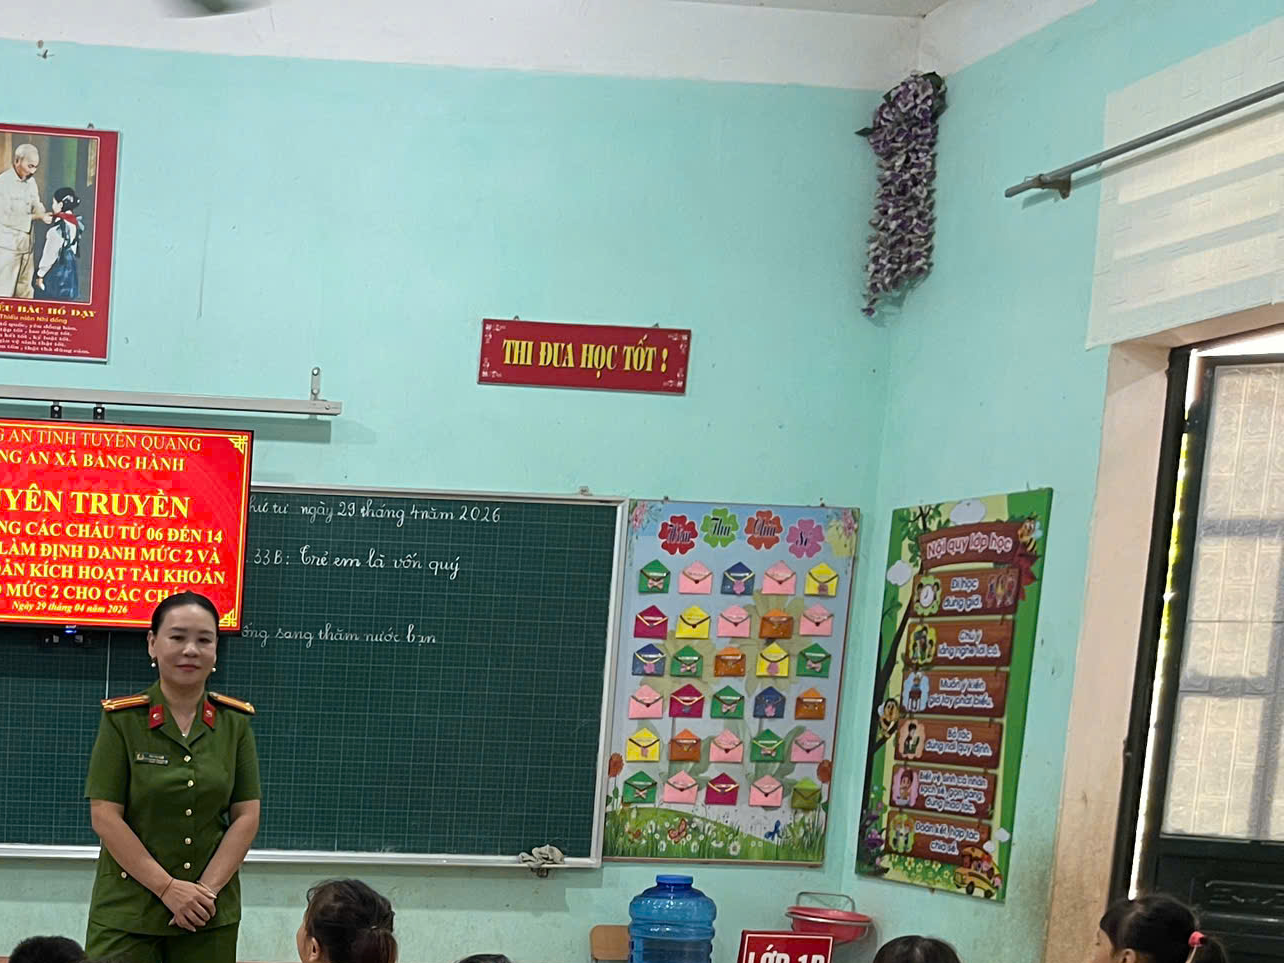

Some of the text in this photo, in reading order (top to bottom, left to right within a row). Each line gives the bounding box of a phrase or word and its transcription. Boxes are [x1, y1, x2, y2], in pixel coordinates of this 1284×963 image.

[503, 339, 534, 366] THI
[538, 341, 575, 368] ĐUA
[580, 343, 618, 378] HỌC
[622, 334, 657, 372] TỐT
[8, 429, 32, 444] AN
[141, 435, 202, 452] QUANG
[26, 451, 51, 465] AN
[54, 450, 78, 467] XÃ
[136, 453, 185, 472] HÀNH
[70, 488, 191, 519] TRUYỀN
[25, 519, 62, 537] CÁC
[66, 521, 115, 539] CHÁU
[119, 522, 145, 540] TỪ
[147, 528, 163, 541] 06
[167, 525, 202, 543] ĐẾN
[207, 530, 223, 544] 14
[40, 543, 83, 561] ĐỊNH
[88, 546, 136, 561] DANH
[140, 545, 181, 563] MỨC
[185, 550, 193, 564] 2
[197, 548, 221, 565] VÀ
[29, 561, 74, 579] KÍCH
[78, 565, 127, 584] HOẠT
[131, 565, 159, 583] TÀI
[164, 567, 226, 585] KHOẢN
[6, 580, 47, 598] MỨC
[51, 587, 60, 599] 2
[63, 586, 101, 600] CHO
[105, 585, 141, 602] CÁC
